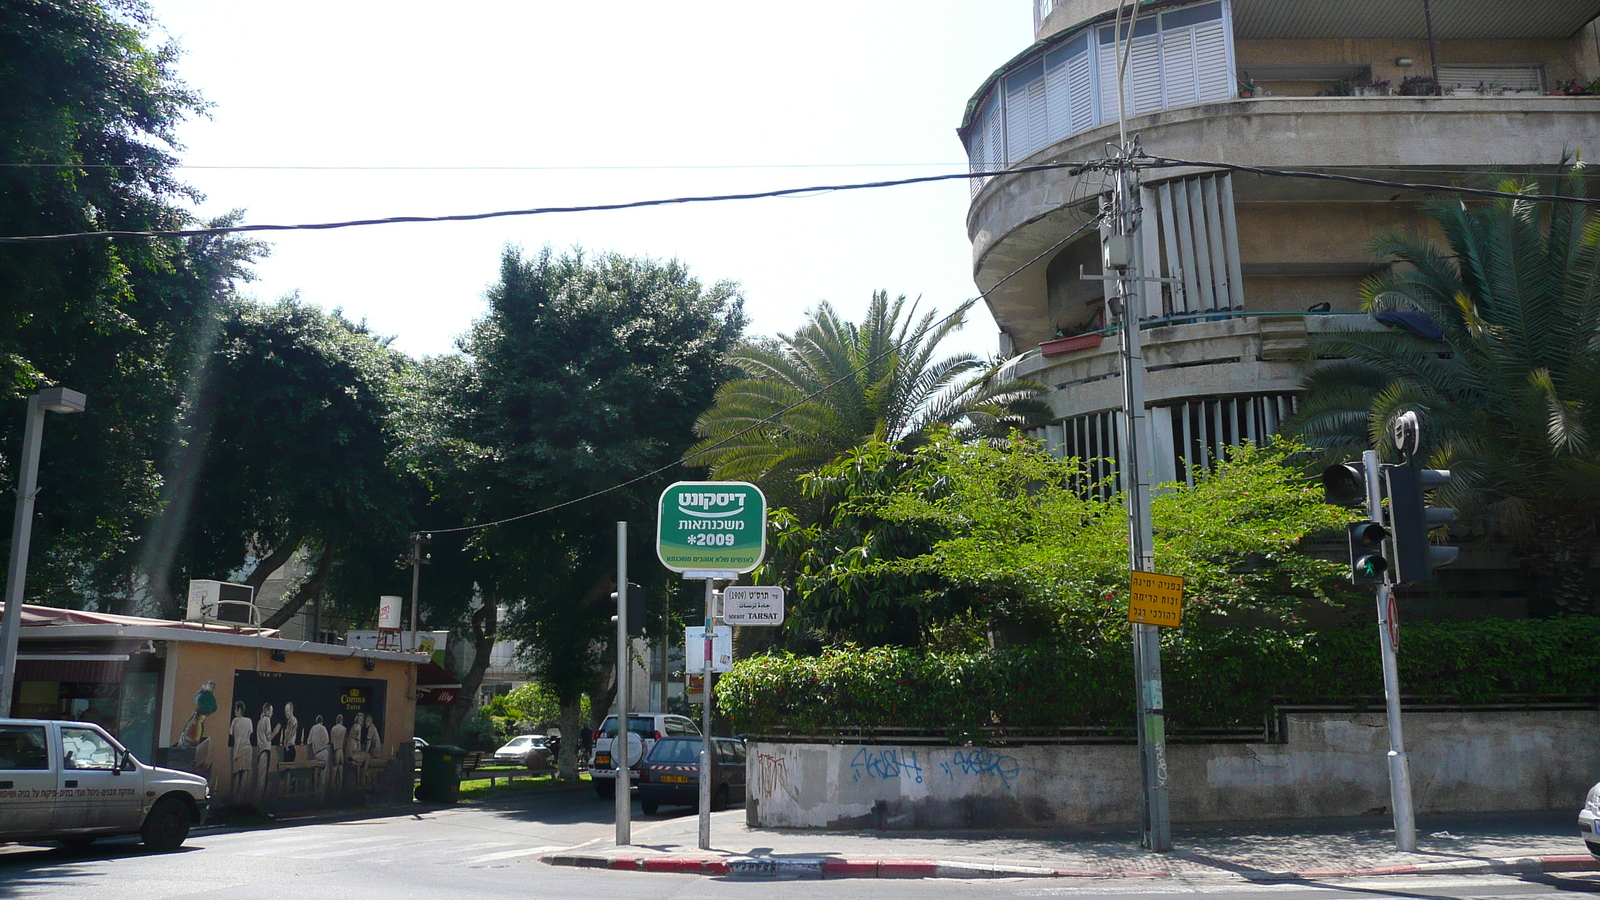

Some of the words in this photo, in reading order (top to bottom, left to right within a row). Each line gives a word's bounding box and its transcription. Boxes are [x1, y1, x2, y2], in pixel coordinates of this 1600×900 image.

[678, 493, 746, 510] דיסקונט
[678, 520, 745, 530] משכנתאות
[1133, 578, 1155, 587] ימינה
[1158, 581, 1180, 591] בפניה
[729, 591, 746, 600] (1909)
[1134, 593, 1158, 604] קדימה
[1161, 597, 1178, 605] זכות
[1133, 607, 1146, 617] רגל
[1150, 610, 1176, 620] להולכי
[341, 694, 365, 704] Corona
[438, 692, 453, 702] illy
[32, 788, 40, 798] על
